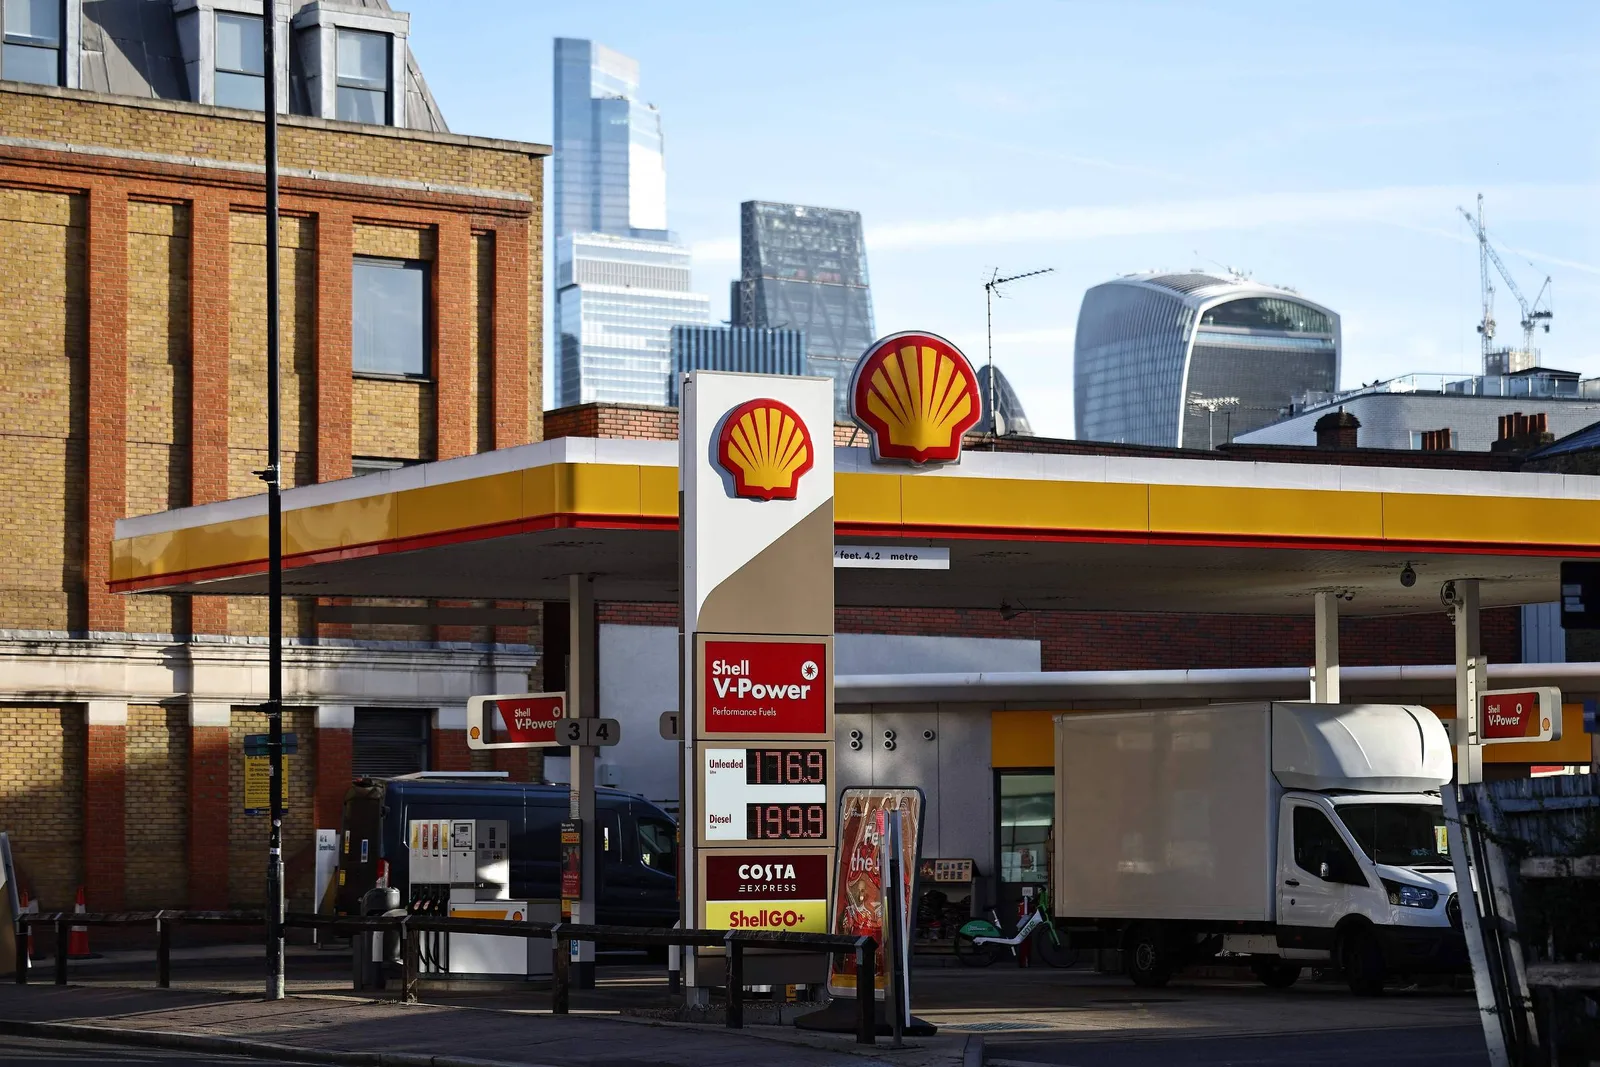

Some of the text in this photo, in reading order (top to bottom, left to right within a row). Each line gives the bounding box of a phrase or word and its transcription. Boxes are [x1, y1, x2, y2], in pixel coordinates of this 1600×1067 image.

[840, 551, 861, 560] feet.
[864, 552, 880, 560] 4.2
[890, 553, 918, 561] metre
[712, 660, 749, 676] Shell
[712, 678, 810, 700] V-Power
[514, 708, 531, 718] Shell
[712, 707, 777, 717] Performance Fuels
[1488, 704, 1500, 714] Shell
[515, 719, 558, 730] V-Power
[670, 716, 677, 734] 1
[1488, 715, 1520, 726] V-Power
[568, 722, 609, 741] 3 4
[709, 759, 744, 769] Unleaded
[755, 751, 823, 784] 176.9
[709, 814, 732, 823] Diesel
[755, 805, 824, 838] 199.9
[864, 825, 879, 846] Fe
[851, 848, 873, 872] the
[738, 864, 797, 882] COSTA
[747, 884, 797, 892] EXPRESS
[729, 910, 805, 928] ShellGO+
